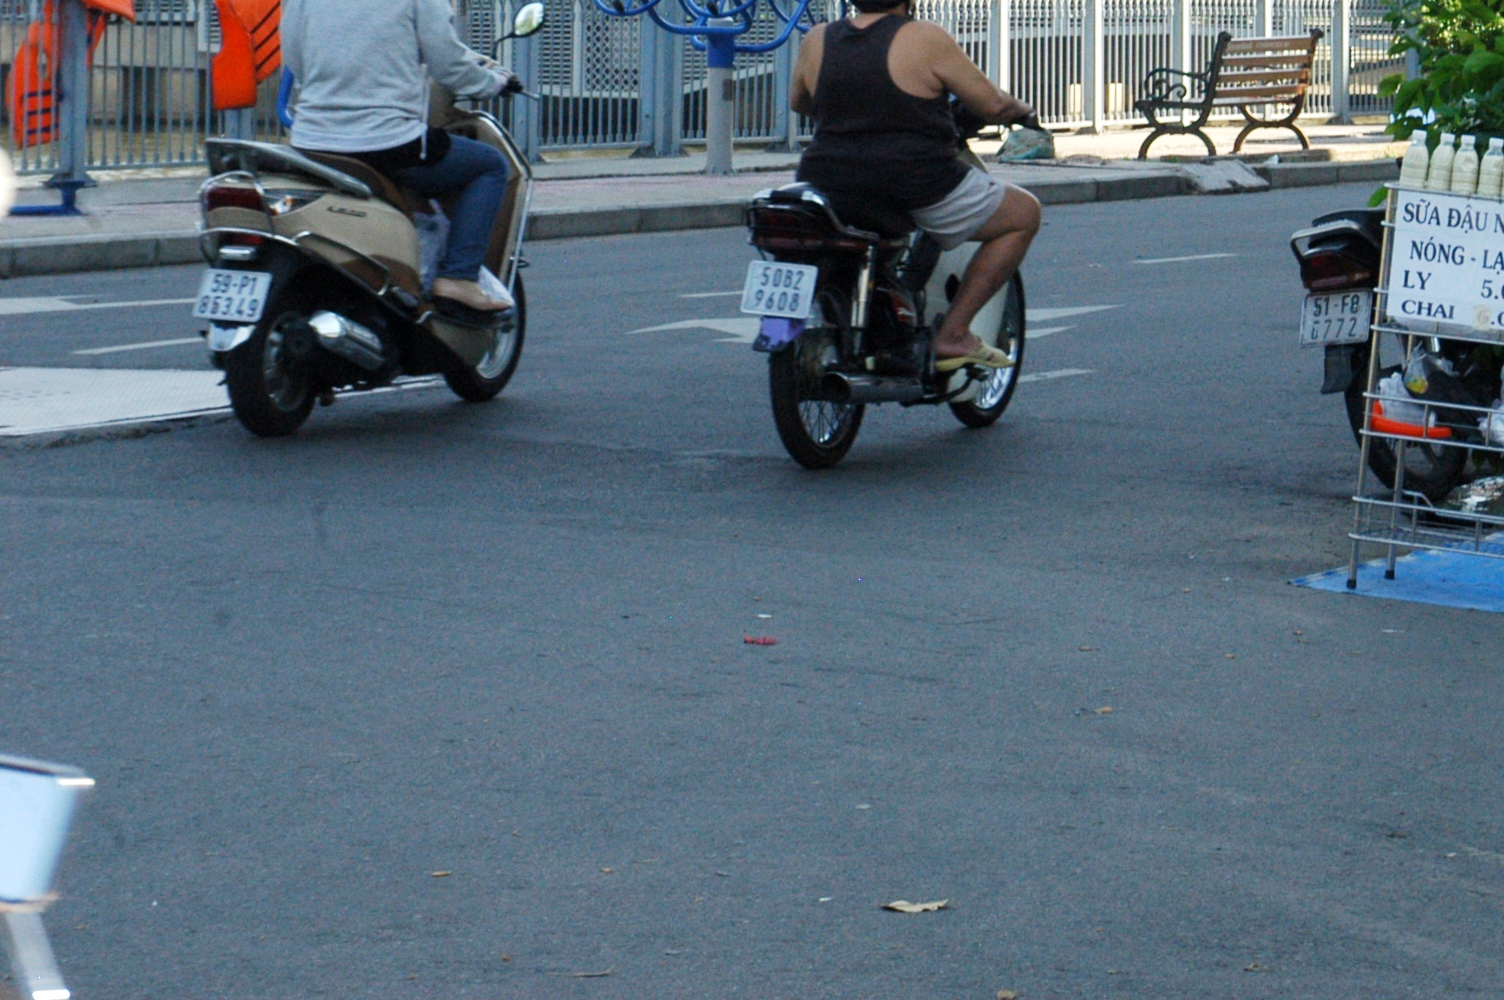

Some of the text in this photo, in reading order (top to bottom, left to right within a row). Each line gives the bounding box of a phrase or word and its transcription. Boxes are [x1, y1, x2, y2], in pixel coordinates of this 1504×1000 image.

[1402, 199, 1441, 227] SỮA
[1447, 204, 1488, 234] ĐẬU
[1409, 236, 1465, 266] NÓNG
[211, 273, 258, 296] 59-P1
[1402, 269, 1432, 291] LY
[755, 288, 801, 312] 9608
[1313, 294, 1360, 318] 51-F8
[1400, 299, 1455, 320] CHAI
